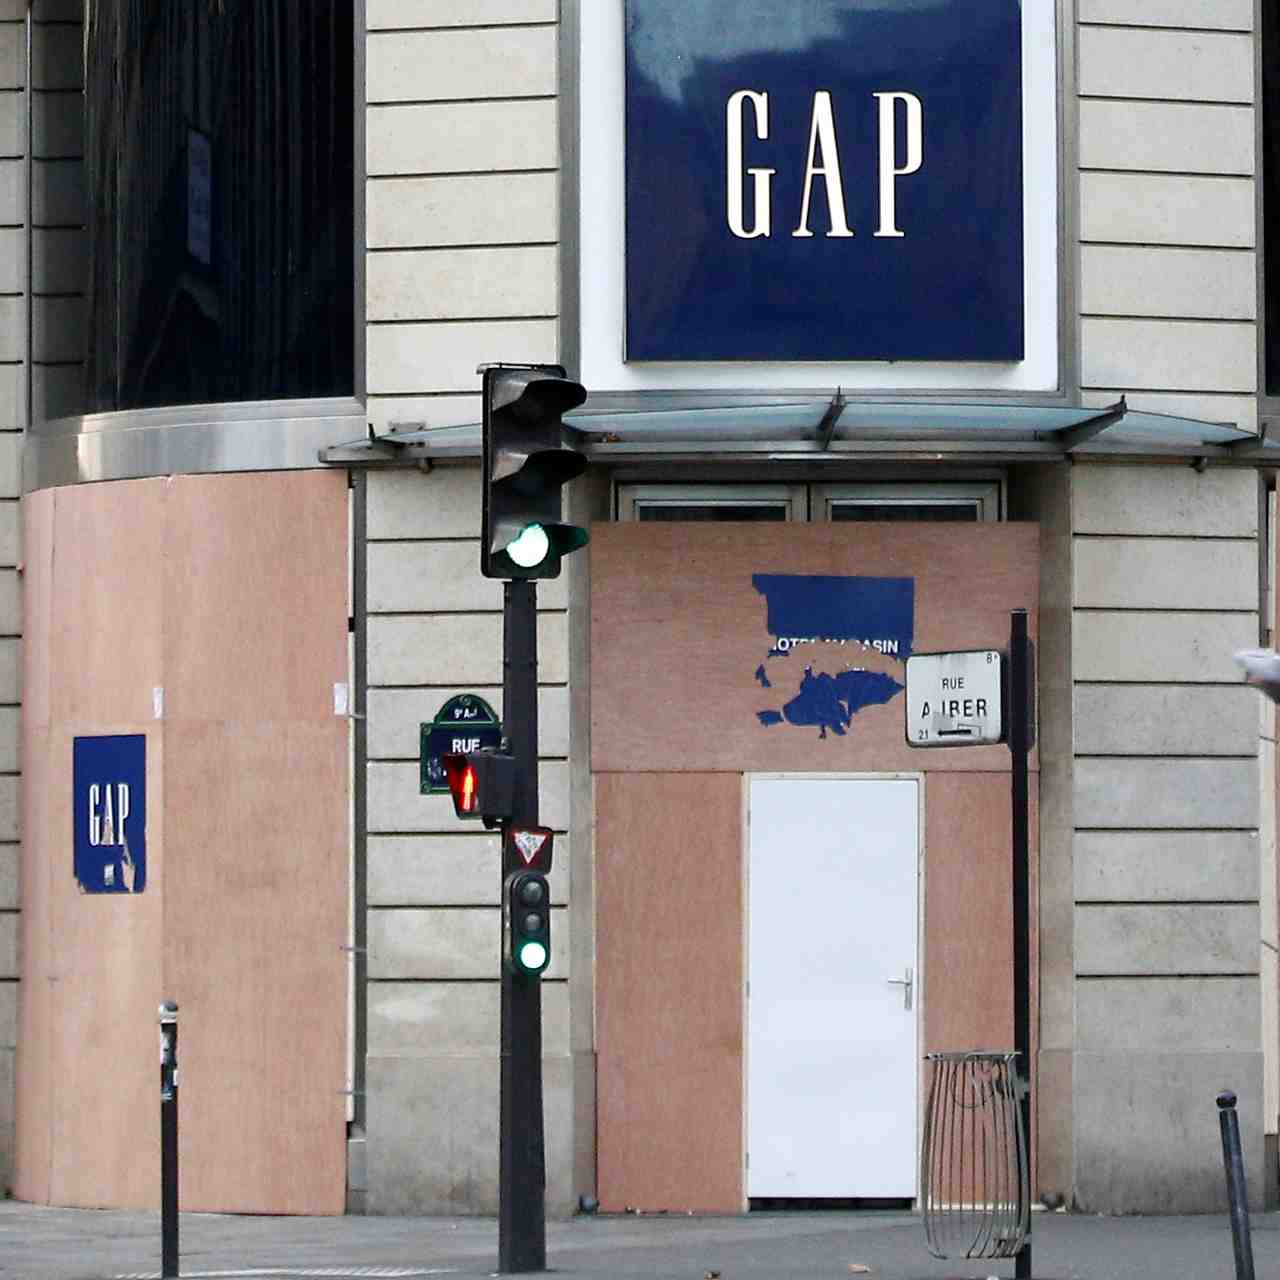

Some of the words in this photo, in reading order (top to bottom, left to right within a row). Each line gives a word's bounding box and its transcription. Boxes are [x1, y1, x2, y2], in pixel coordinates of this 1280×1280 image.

[725, 89, 922, 239] GAP
[941, 677, 965, 690] RUE
[451, 738, 481, 753] RUE
[88, 783, 130, 846] GAP
